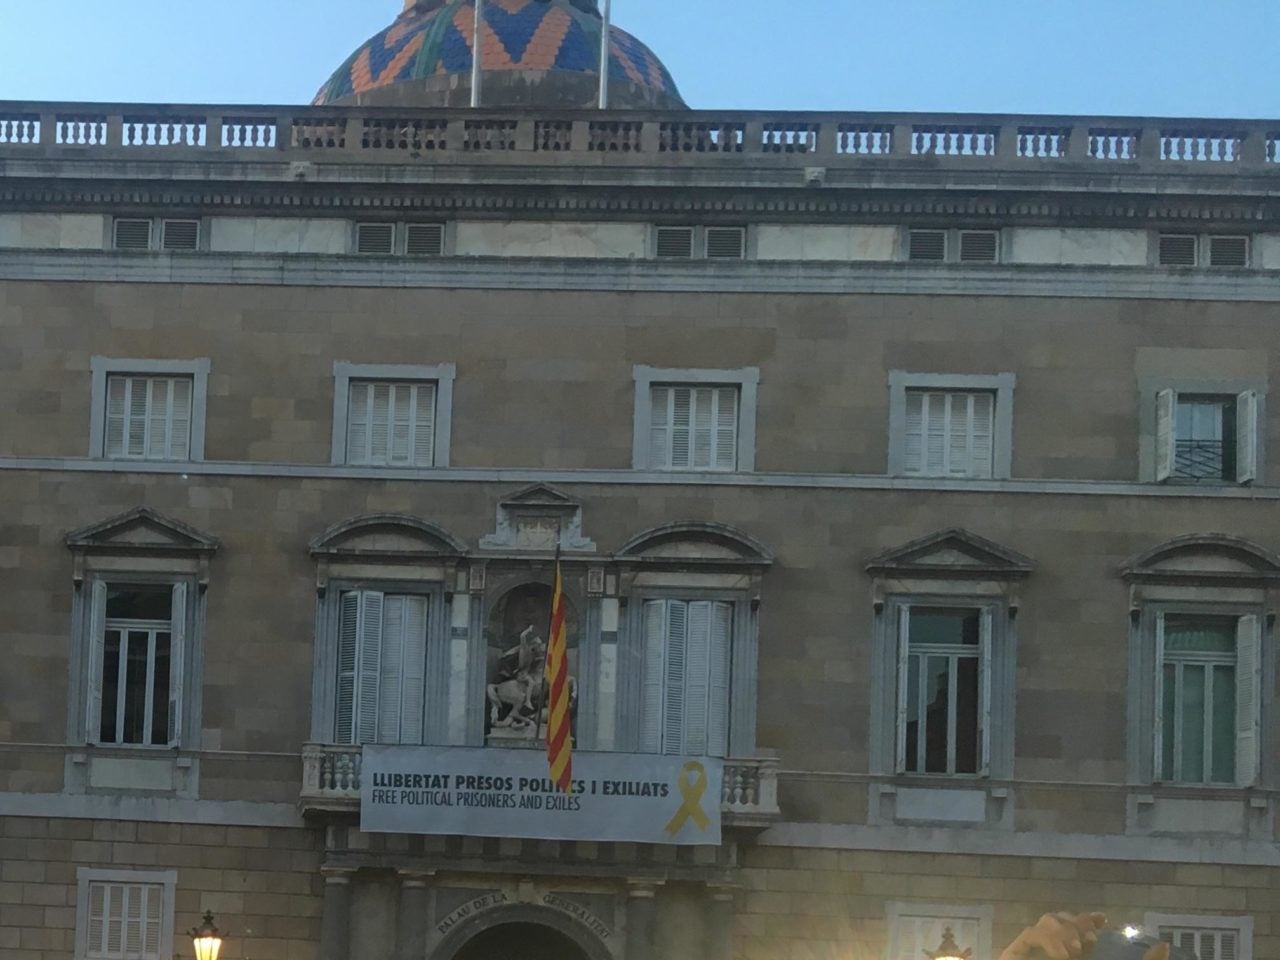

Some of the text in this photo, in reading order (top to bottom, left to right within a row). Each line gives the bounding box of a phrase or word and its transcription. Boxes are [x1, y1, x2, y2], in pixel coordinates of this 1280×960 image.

[372, 772, 450, 790] LLIBERTAT
[455, 775, 513, 791] PRESOS
[591, 780, 597, 795] I
[602, 780, 669, 798] EXILIATS
[372, 789, 581, 811] FREE POLITICAL PRISONERS AND EXILES
[437, 893, 611, 939] PALAU DE LA GENERALITAT
